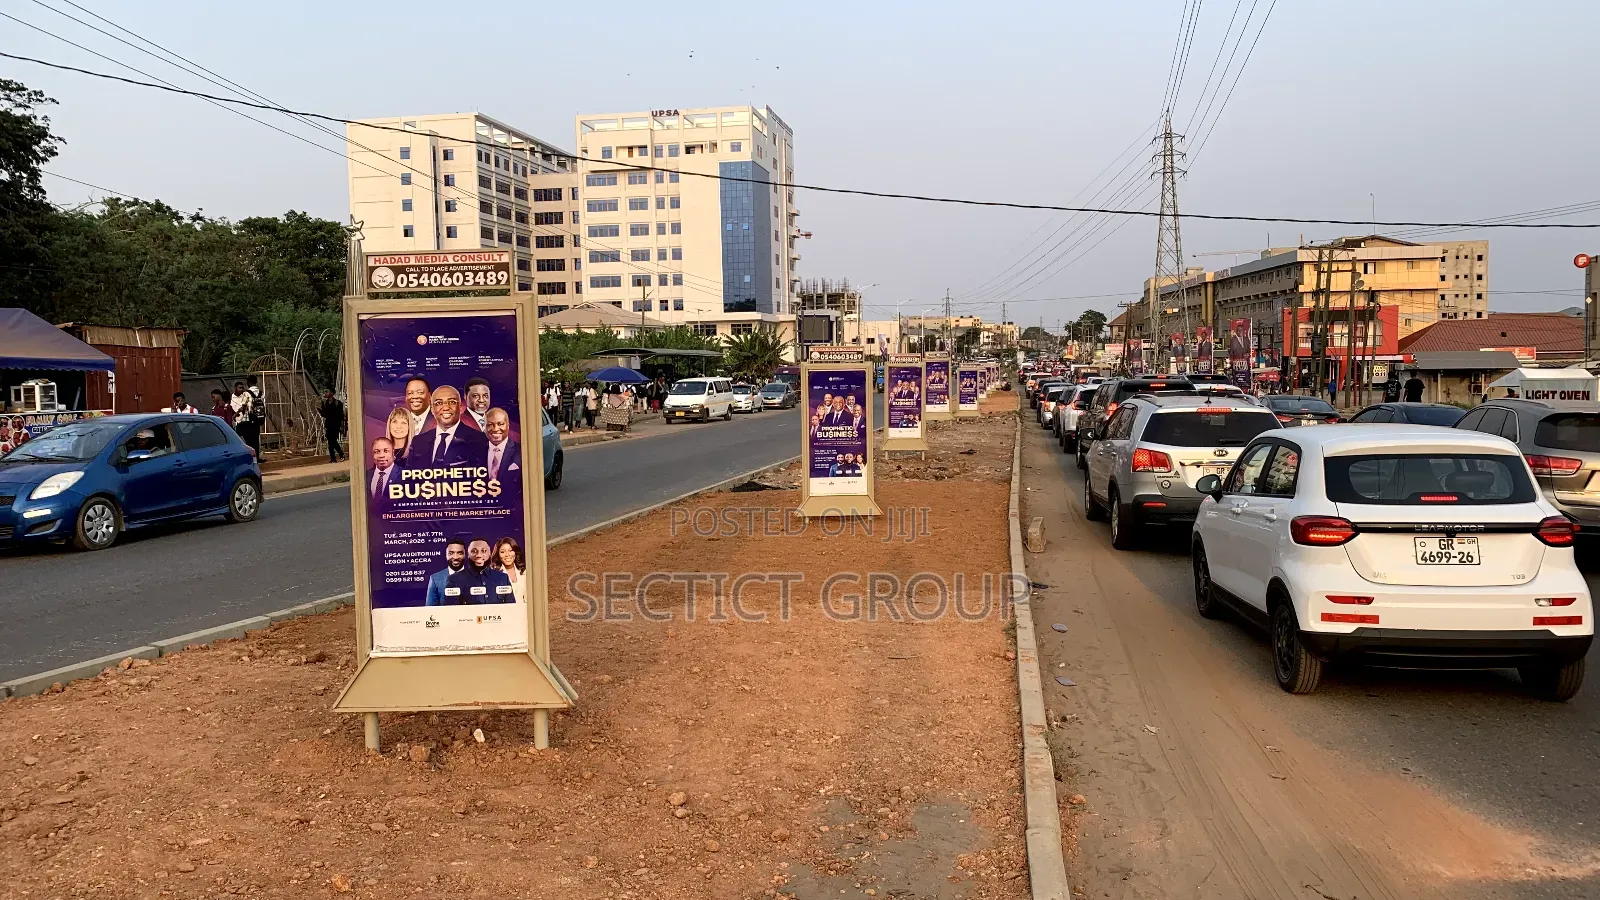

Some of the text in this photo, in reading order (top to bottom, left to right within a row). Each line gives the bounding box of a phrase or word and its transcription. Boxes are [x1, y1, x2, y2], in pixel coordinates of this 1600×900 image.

[651, 109, 680, 117] UPSA
[373, 254, 504, 265] HADAD MEDIA CONSULT
[396, 270, 508, 288] 0540603489
[1526, 390, 1590, 400] LIGHT OVEN
[402, 466, 488, 480] PROPHETIC
[1438, 538, 1454, 551] GR
[1421, 551, 1474, 564] 4699-26
